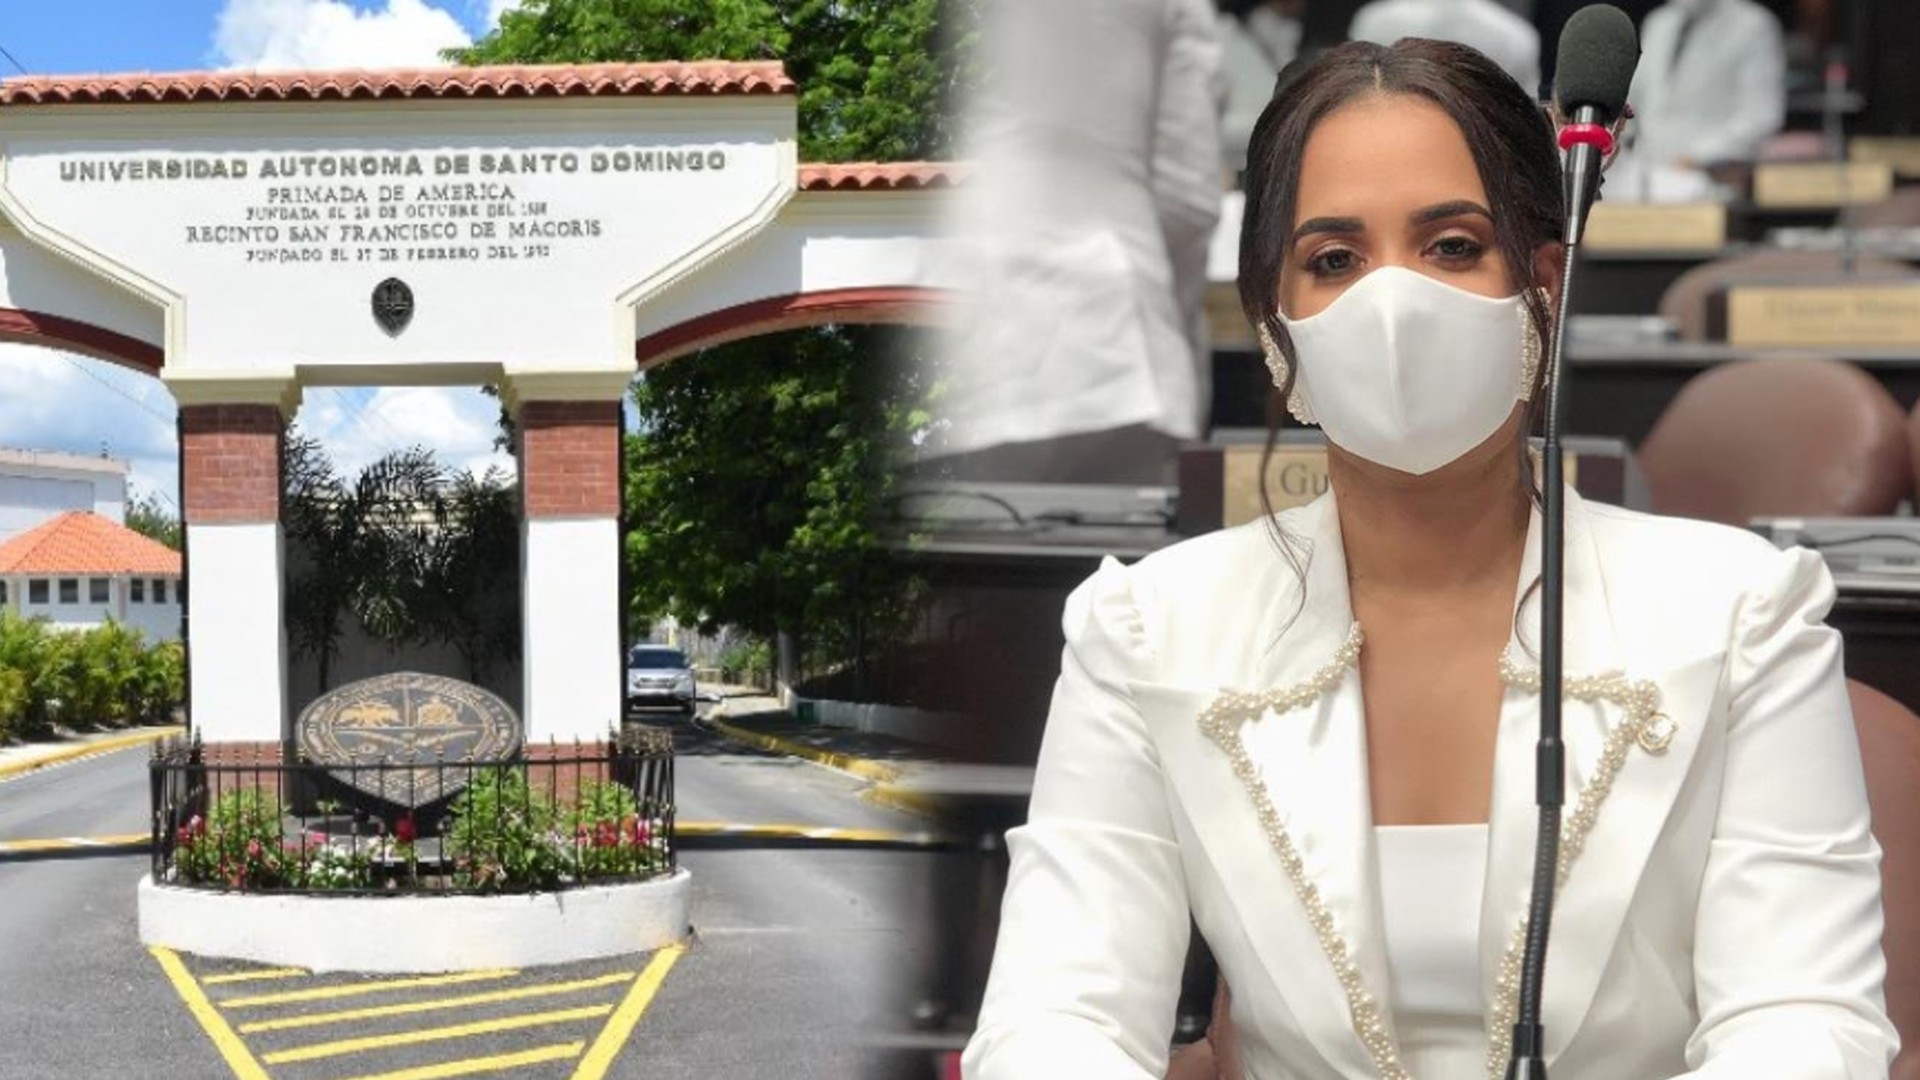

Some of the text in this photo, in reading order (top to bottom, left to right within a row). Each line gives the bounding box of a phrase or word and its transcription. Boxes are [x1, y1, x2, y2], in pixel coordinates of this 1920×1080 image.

[60, 150, 726, 182] UNIVERSIDAD AUTONOMA DE SANTO DOMINGO
[267, 182, 516, 203] PRIMADA DE AMERICA
[378, 205, 397, 219] DE
[405, 203, 479, 218] OCTUBRE
[486, 203, 515, 218] DEL
[186, 219, 602, 243] RECINTO SAN FRANCISCO DE MACORIS
[379, 247, 399, 261] DE
[407, 246, 479, 261] FEBRERO
[486, 245, 518, 259] DEL
